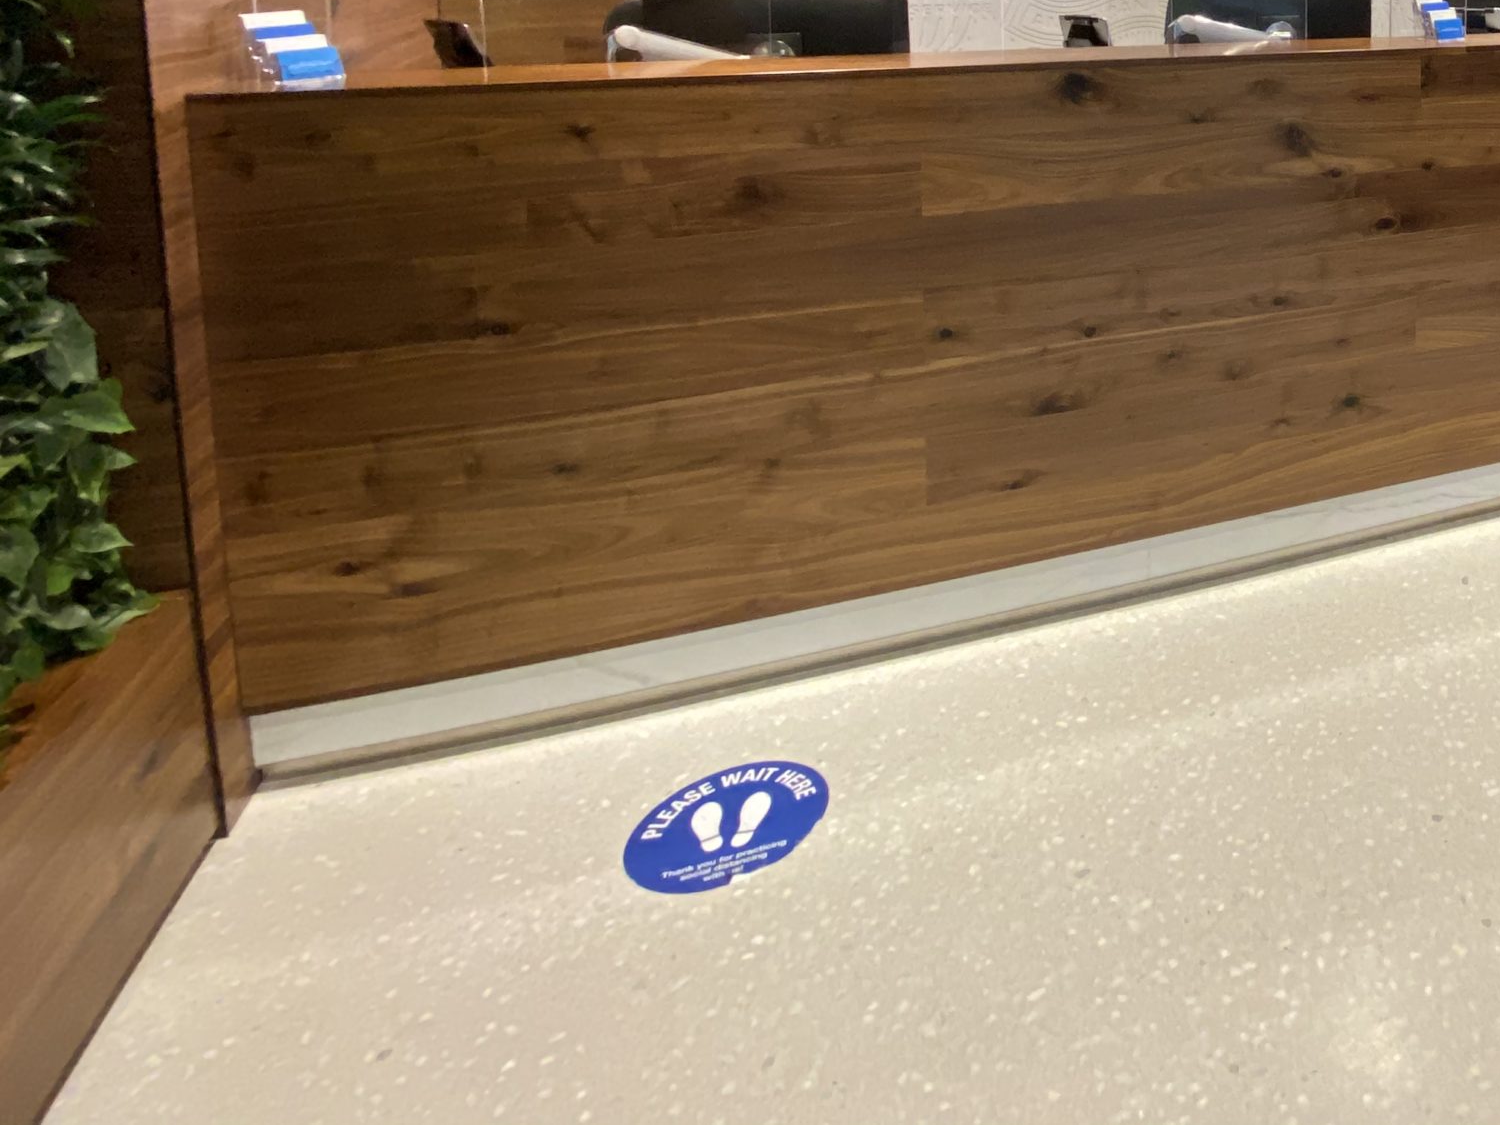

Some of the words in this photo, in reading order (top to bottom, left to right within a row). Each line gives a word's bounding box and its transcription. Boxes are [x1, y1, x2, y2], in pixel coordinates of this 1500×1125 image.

[641, 781, 716, 840] PLEASE
[721, 767, 779, 787] WAIT
[774, 769, 817, 801] HERE
[662, 865, 694, 879] Thank
[697, 859, 717, 870] you
[719, 854, 735, 863] for
